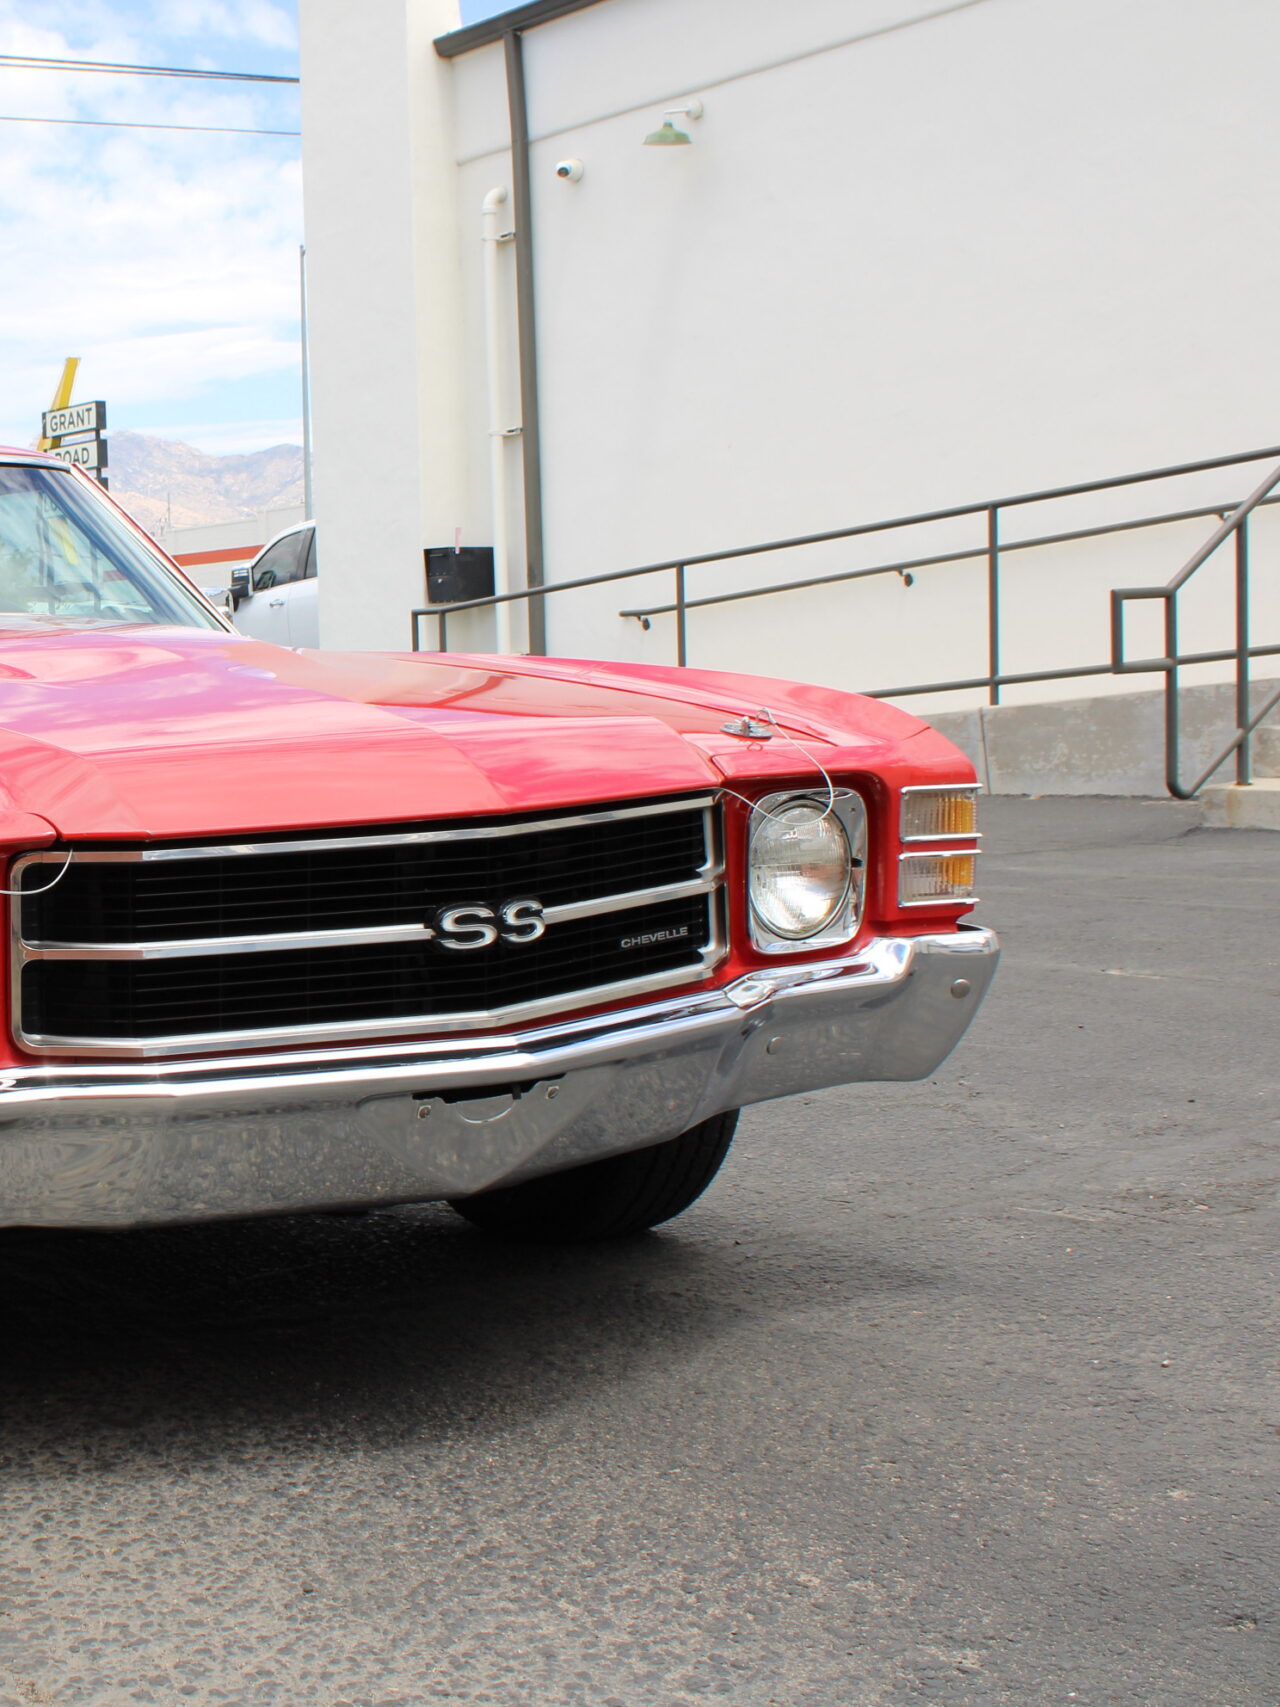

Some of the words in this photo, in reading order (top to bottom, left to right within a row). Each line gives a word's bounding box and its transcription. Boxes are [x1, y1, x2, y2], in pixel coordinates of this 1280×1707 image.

[49, 407, 92, 432] GRANT
[438, 899, 546, 950] SS
[621, 926, 689, 948] CHEVELLE
